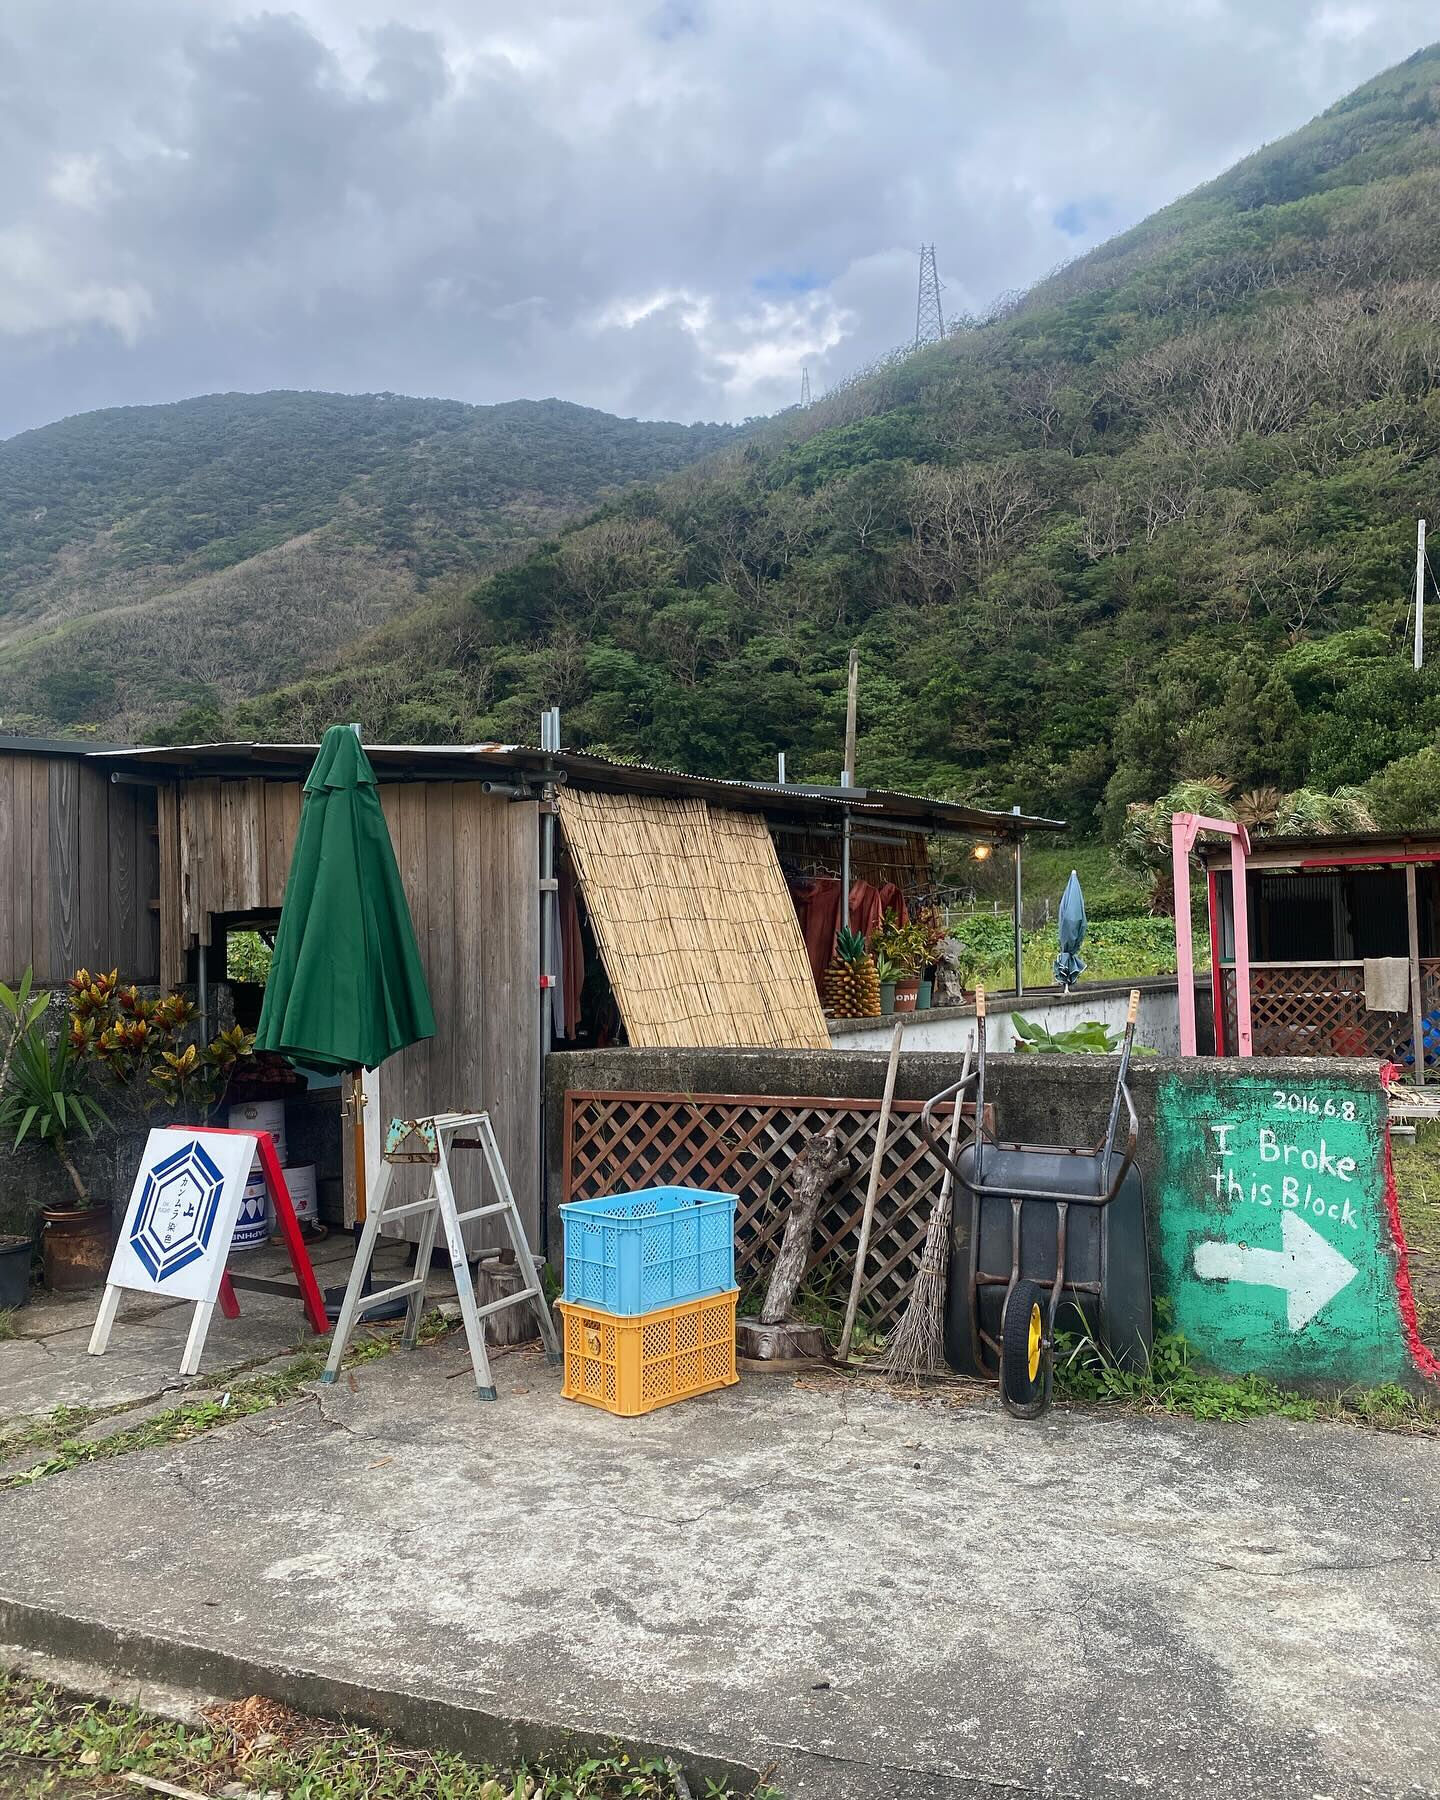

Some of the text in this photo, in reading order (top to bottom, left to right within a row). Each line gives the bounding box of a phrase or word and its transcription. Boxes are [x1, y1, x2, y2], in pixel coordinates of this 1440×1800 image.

[1210, 1125, 1356, 1182] I Broke
[1209, 1166, 1358, 1229] this Block
